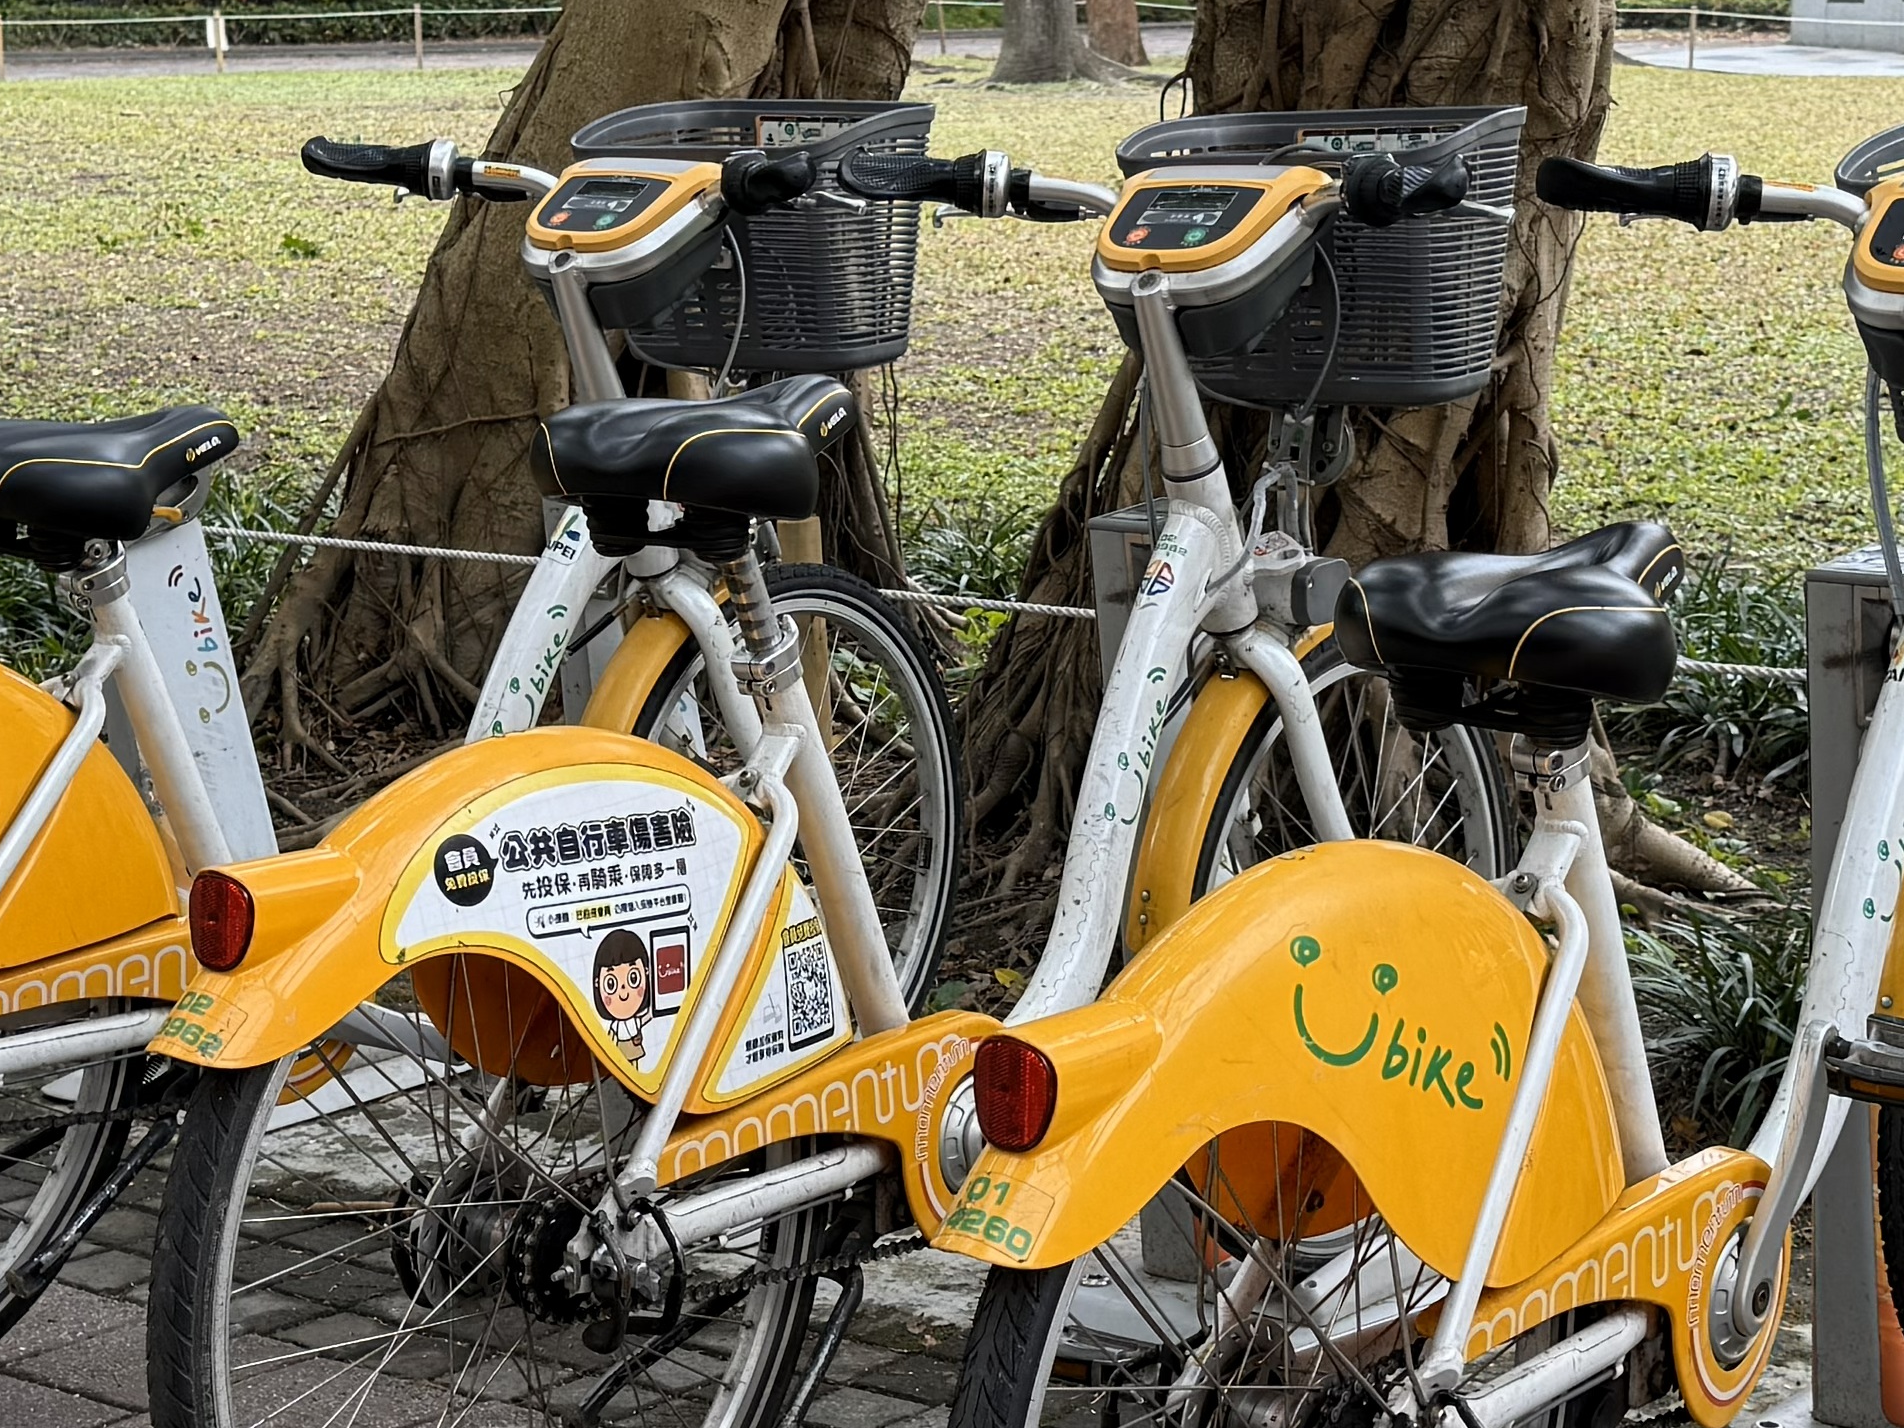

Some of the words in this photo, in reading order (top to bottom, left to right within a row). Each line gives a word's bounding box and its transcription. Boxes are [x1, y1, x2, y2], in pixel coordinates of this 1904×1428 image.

[500, 808, 696, 870] 公共自行車傷害險
[444, 845, 481, 872] 會員
[966, 1175, 1011, 1206] 01
